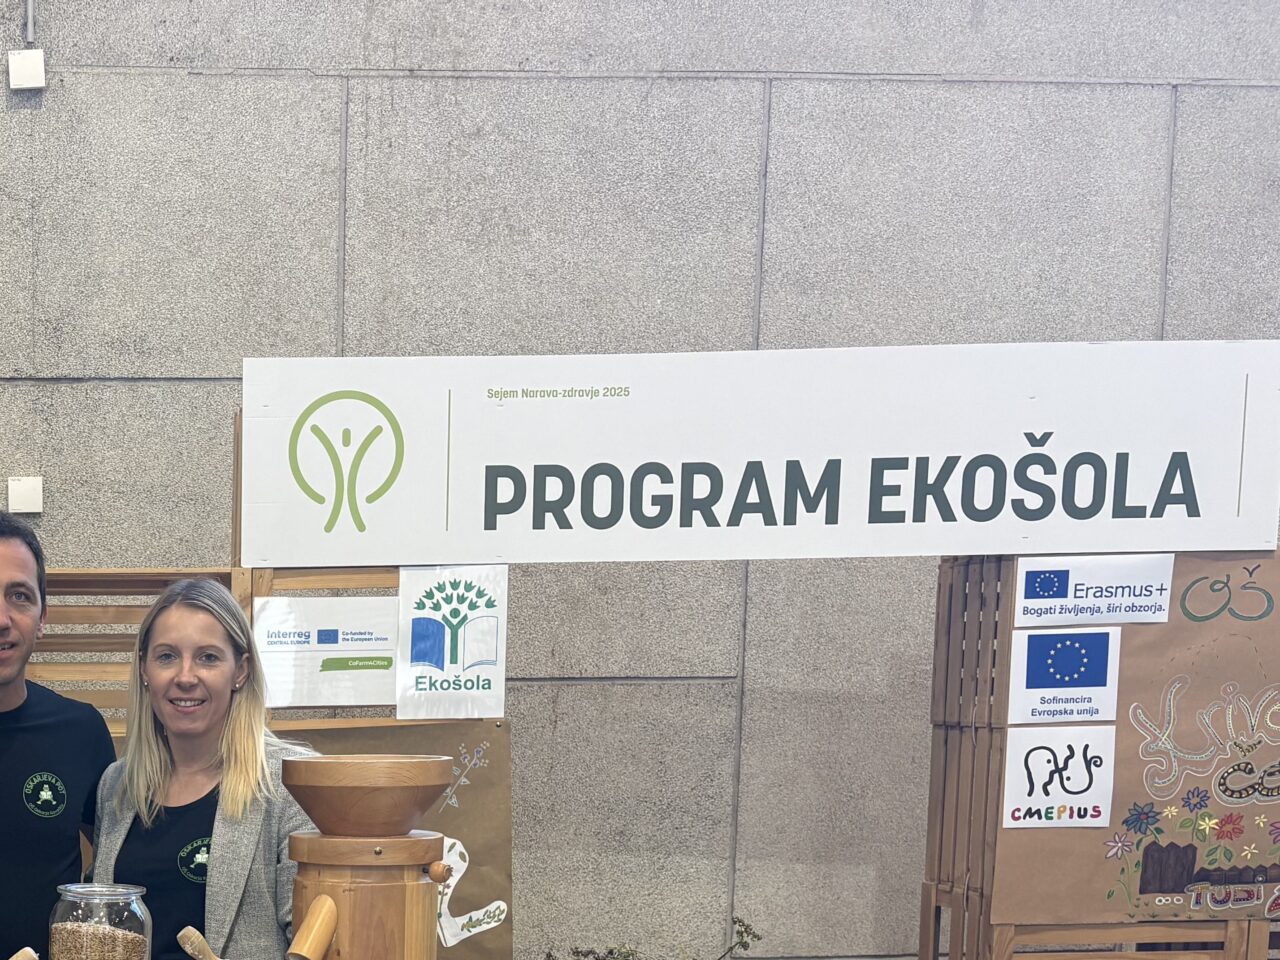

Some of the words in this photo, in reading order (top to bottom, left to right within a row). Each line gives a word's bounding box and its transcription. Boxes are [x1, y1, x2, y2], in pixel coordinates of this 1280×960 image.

[487, 388, 518, 401] Sejem
[521, 387, 600, 399] Narava-zdravje
[602, 386, 630, 398] 2025
[484, 458, 842, 531] PROGRAM
[868, 431, 1201, 524] EKOŠOLA
[1074, 583, 1168, 599] Erasmus+
[1180, 564, 1275, 622] OŠ
[1022, 606, 1056, 617] Bogati
[1058, 603, 1103, 616] življenja,
[1107, 603, 1122, 613] širi
[1124, 602, 1165, 615] obzorja.
[267, 630, 310, 640] Interreg
[415, 675, 491, 691] Ekošola
[1040, 695, 1092, 705] Sofinancira
[1031, 708, 1074, 719] Evropska
[1077, 707, 1099, 716] unija
[1011, 805, 1102, 821] CMEPIUS
